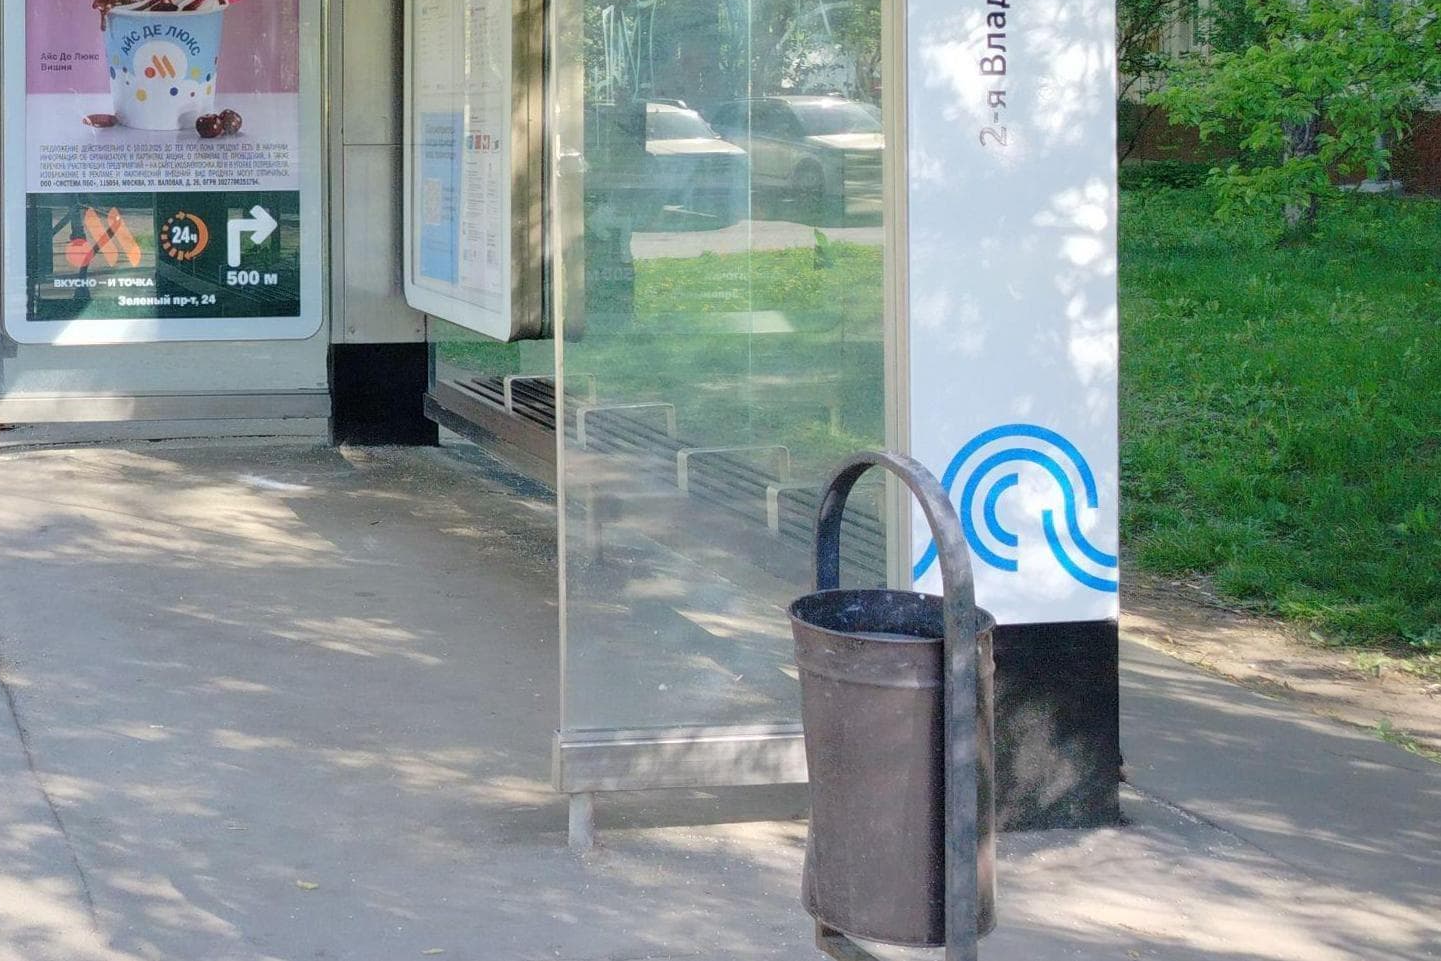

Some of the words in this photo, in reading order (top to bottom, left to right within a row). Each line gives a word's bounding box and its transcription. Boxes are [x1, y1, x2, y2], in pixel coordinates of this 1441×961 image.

[121, 30, 140, 56] АЙС
[143, 24, 162, 39] ДЕ
[166, 26, 201, 56] ЛЮКС
[980, 89, 1007, 148] 2-я
[54, 280, 97, 288] ВКУСНО
[108, 279, 116, 287] И
[118, 278, 154, 288] ТОЧКА
[227, 270, 260, 286] 500
[264, 273, 278, 285] м
[118, 295, 170, 306] Зеленый
[173, 297, 200, 307] пр-т,
[201, 294, 216, 305] 24
